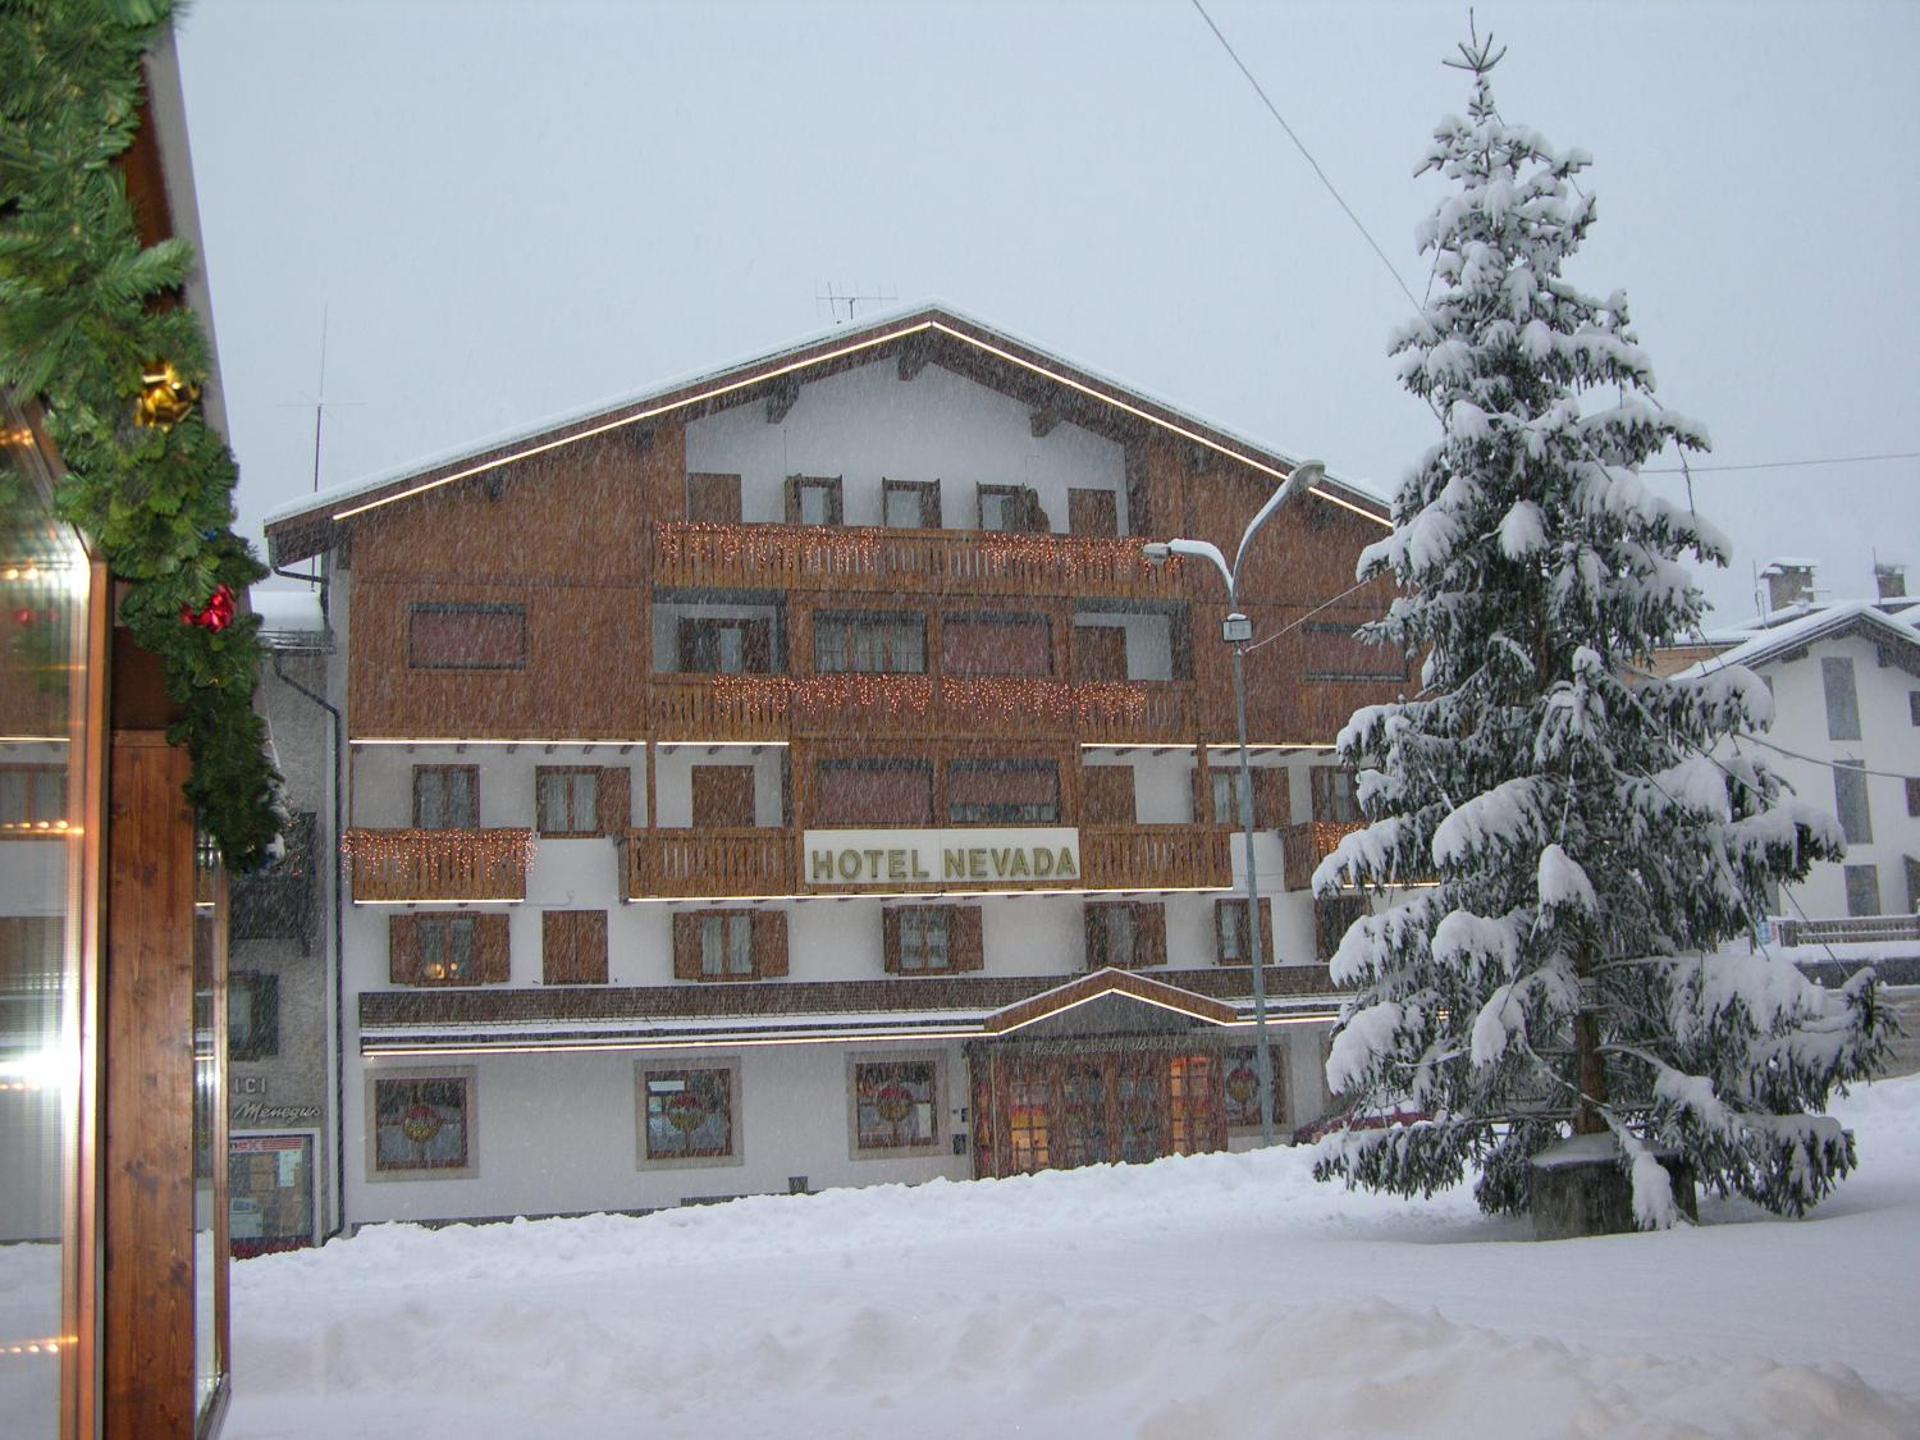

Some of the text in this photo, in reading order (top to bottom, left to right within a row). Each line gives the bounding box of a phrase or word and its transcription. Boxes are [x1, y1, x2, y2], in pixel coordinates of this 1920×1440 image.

[812, 846, 1077, 879] HOTEL NEVADA
[233, 1103, 321, 1124] Menegus
